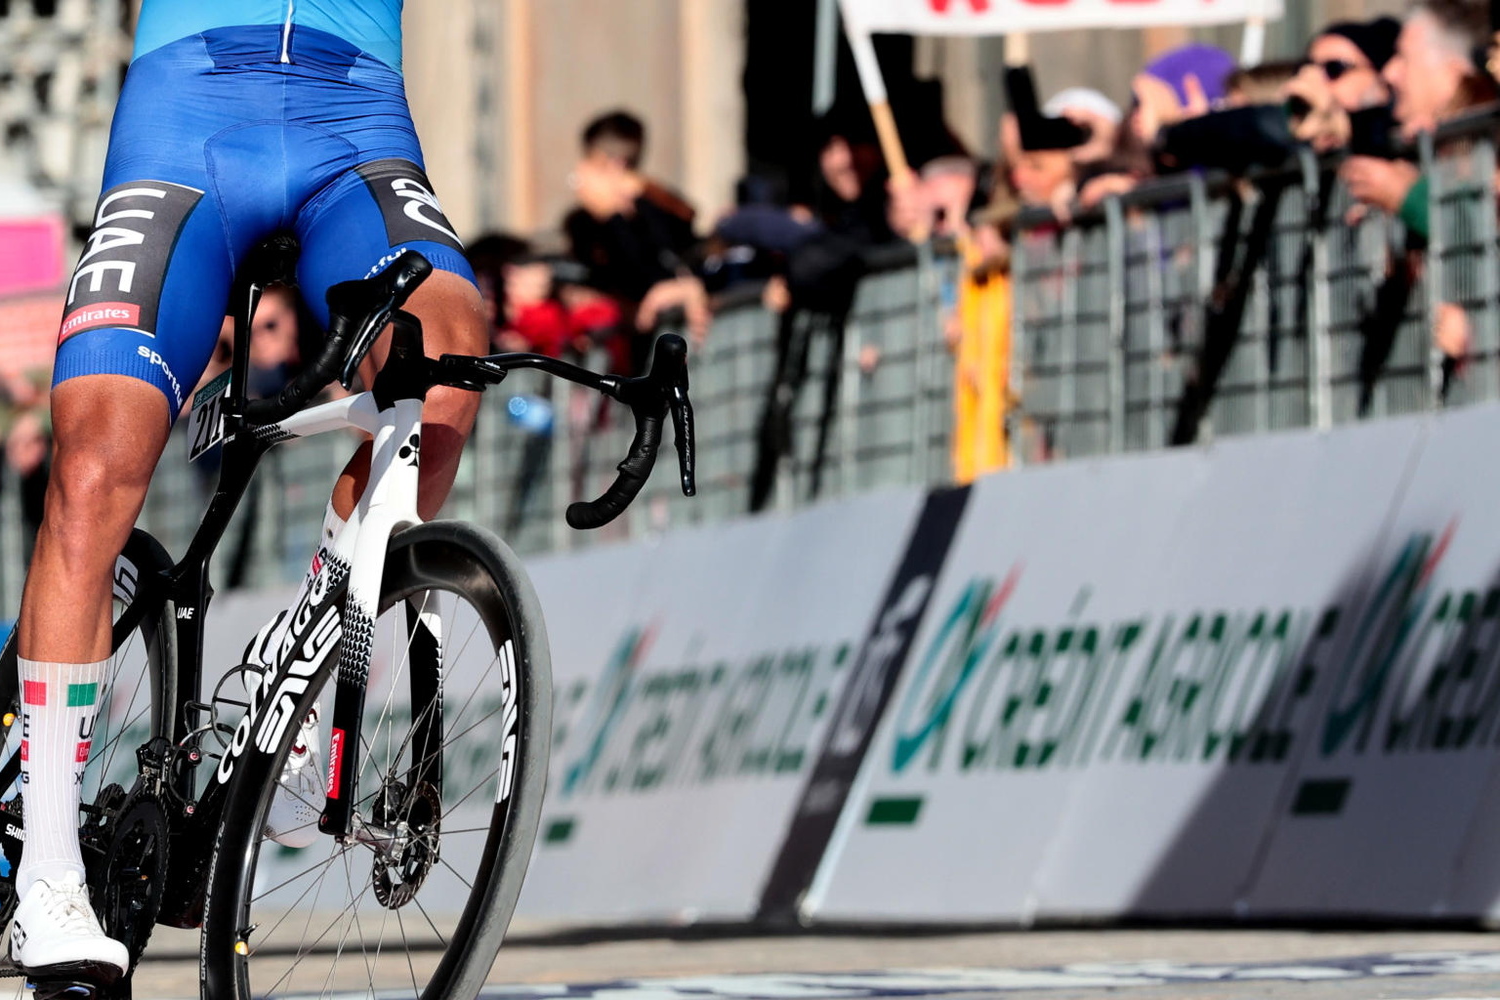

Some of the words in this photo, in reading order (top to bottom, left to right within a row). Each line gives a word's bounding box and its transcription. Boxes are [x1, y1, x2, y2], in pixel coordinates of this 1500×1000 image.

[67, 180, 168, 307] UAE
[363, 247, 407, 280] rtful
[61, 307, 131, 335] Emirates
[137, 345, 183, 410] sportfu
[176, 606, 195, 620] UAE
[254, 604, 343, 754] ENVE
[327, 732, 341, 794] Emirates
